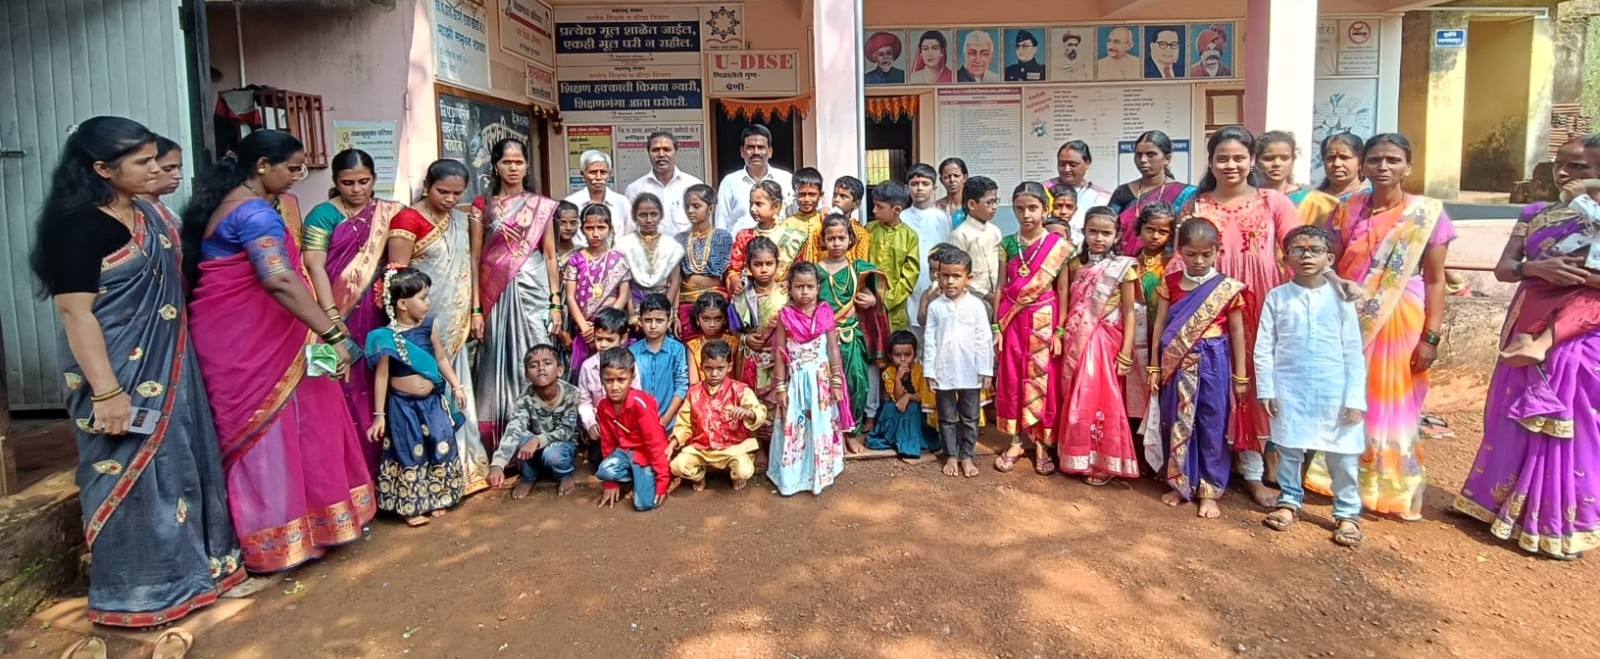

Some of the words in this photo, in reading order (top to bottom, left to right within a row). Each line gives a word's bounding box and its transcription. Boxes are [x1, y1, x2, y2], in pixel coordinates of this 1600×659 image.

[560, 24, 596, 36] प्रत्येक
[600, 26, 619, 39] मूल
[624, 23, 657, 35] शाळेत
[661, 23, 696, 36] जाईल,
[563, 38, 595, 49] एकही
[599, 39, 619, 52] मूल
[623, 37, 641, 48] घरी
[645, 39, 655, 48] न
[660, 35, 693, 48] राहील.
[714, 54, 793, 70] U-DISE
[560, 81, 591, 94] शिक्षण
[594, 81, 633, 94] हक्काची
[636, 81, 669, 93] किमया
[574, 96, 626, 109] शिक्षणगंगा
[628, 97, 651, 108] आता
